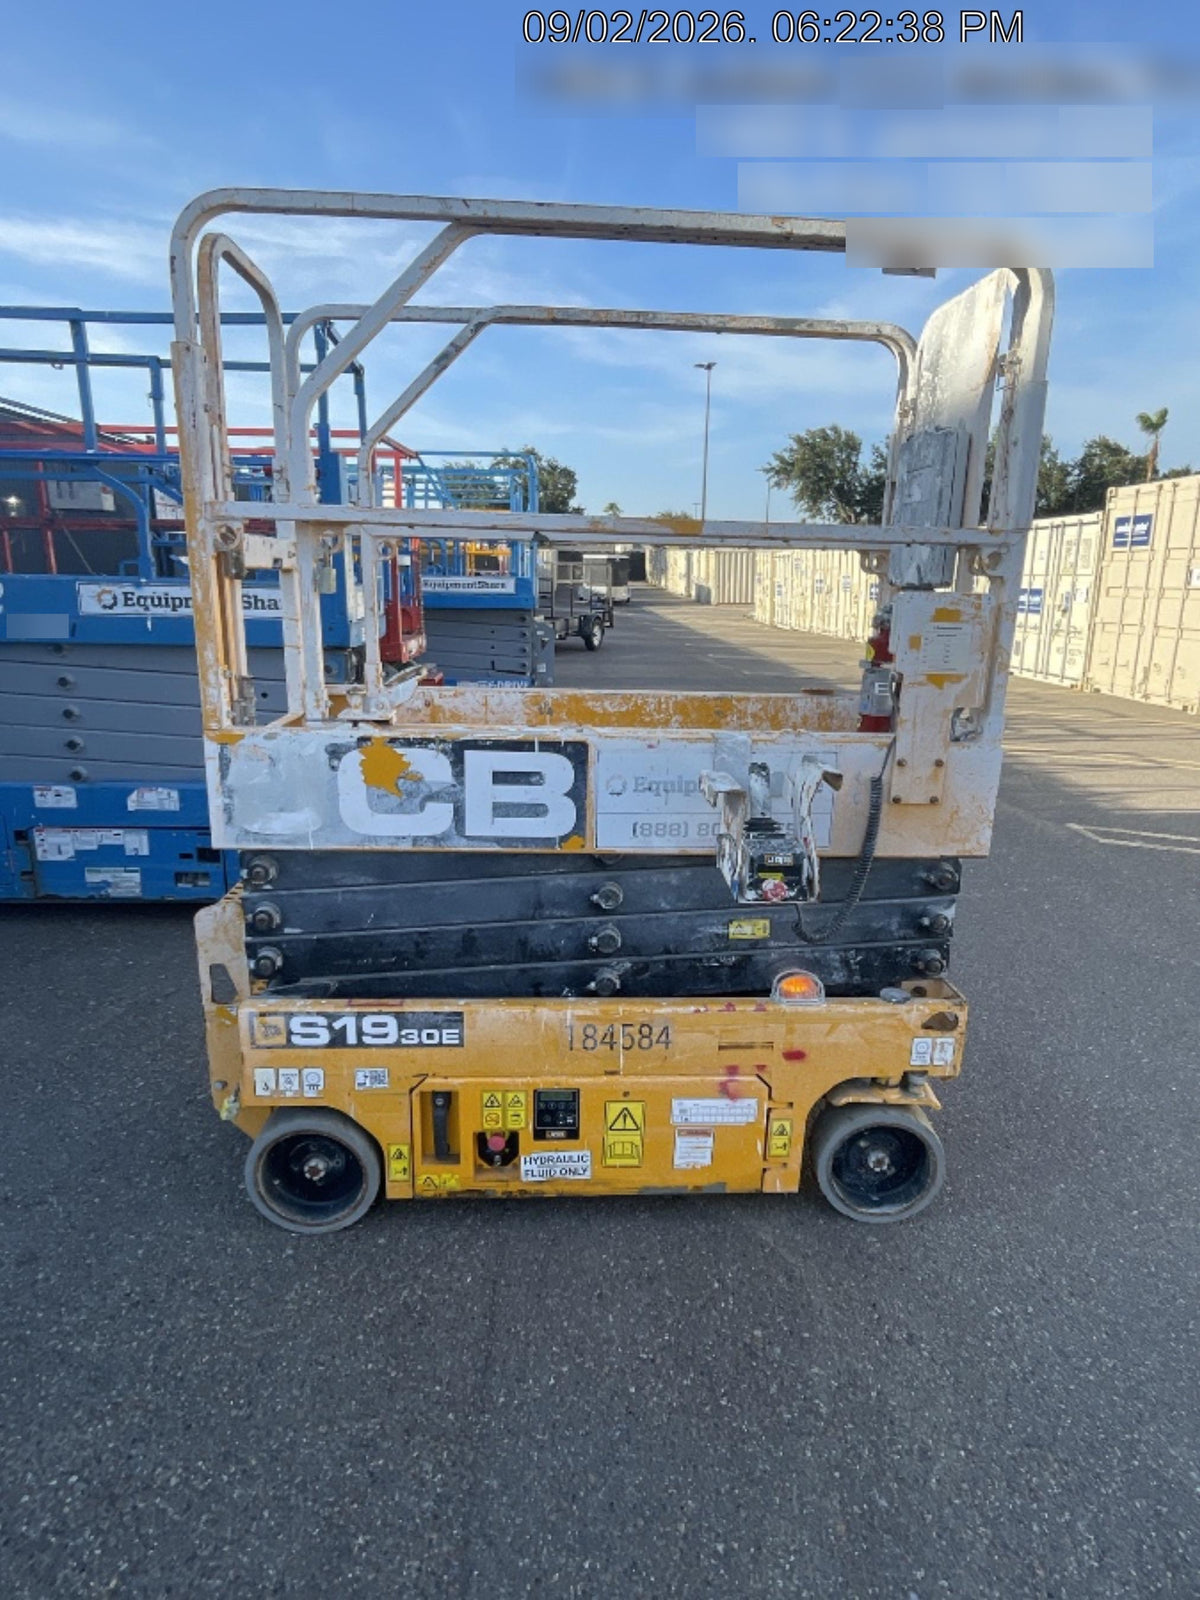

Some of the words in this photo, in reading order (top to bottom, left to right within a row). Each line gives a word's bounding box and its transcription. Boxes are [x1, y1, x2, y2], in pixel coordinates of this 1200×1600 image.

[632, 821, 689, 838] (888)
[566, 1023, 673, 1051] 184584
[523, 1154, 589, 1165] HYDRAULIC
[524, 1168, 557, 1178] FLUID
[559, 1167, 588, 1176] ONLY
